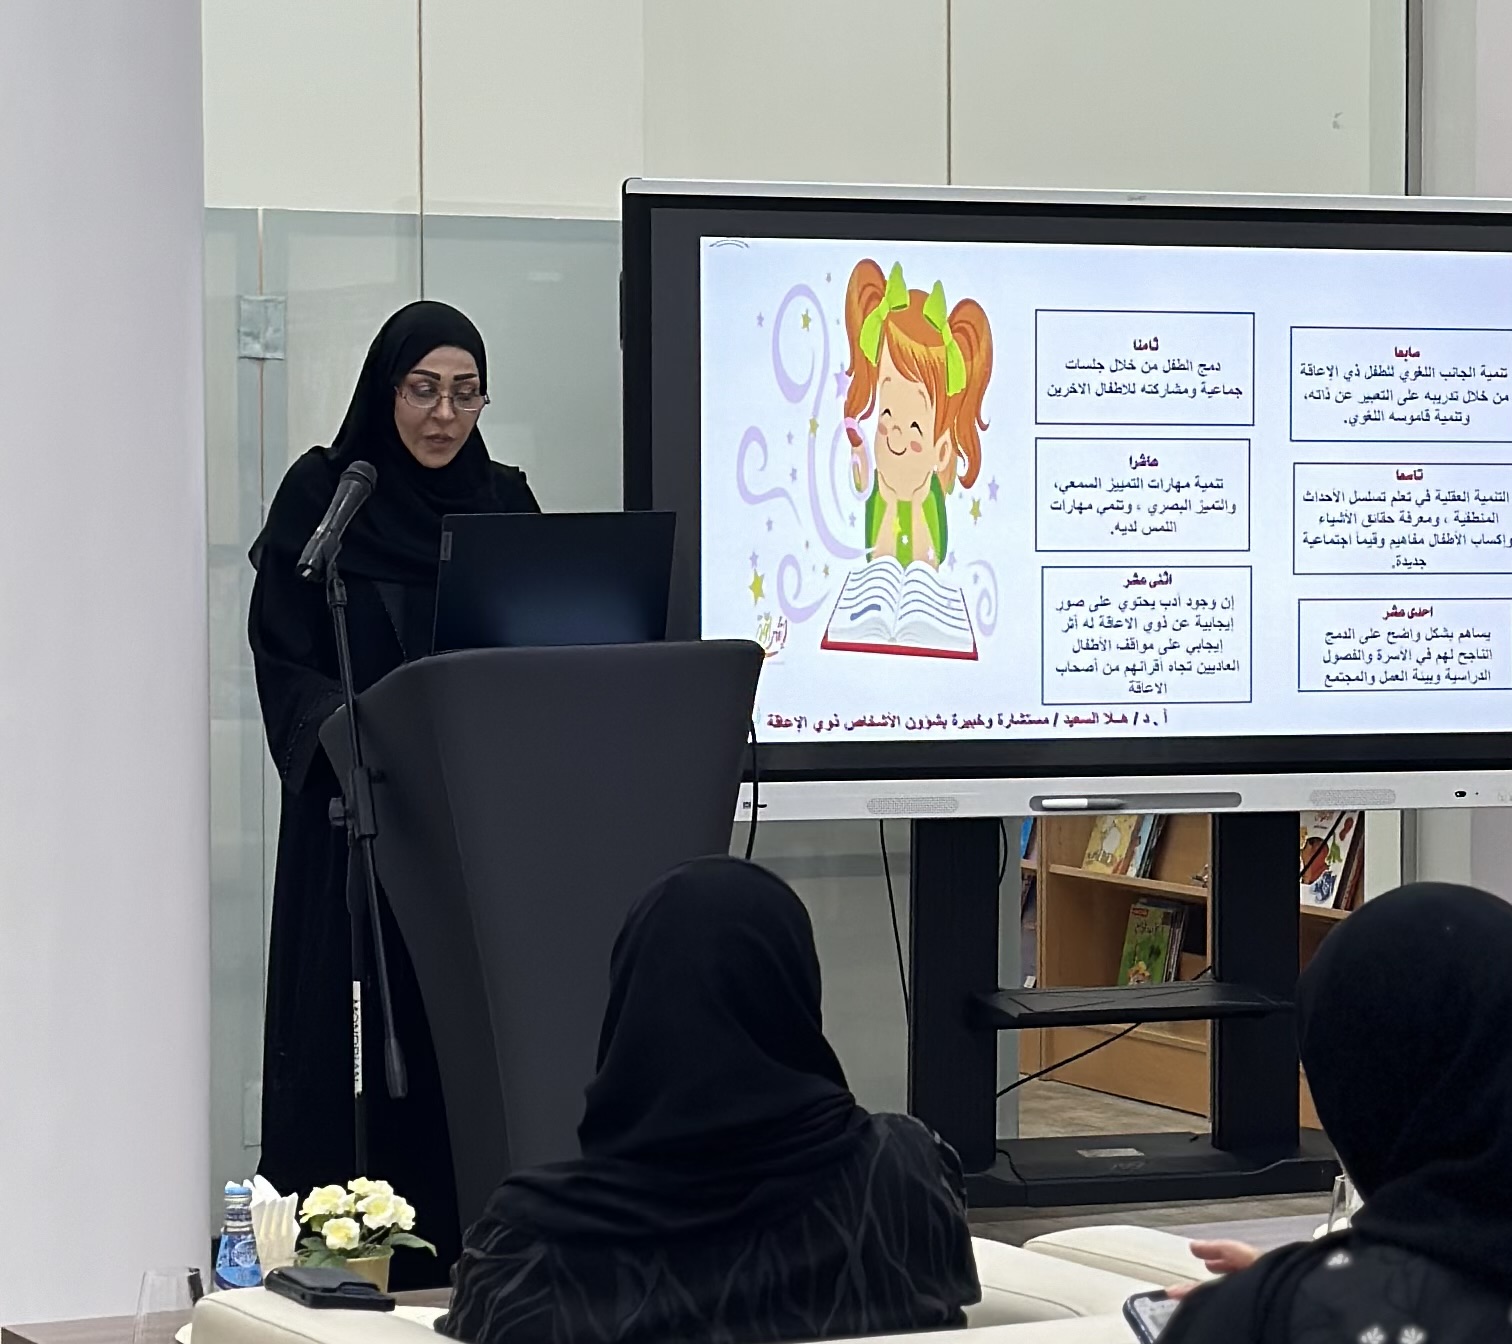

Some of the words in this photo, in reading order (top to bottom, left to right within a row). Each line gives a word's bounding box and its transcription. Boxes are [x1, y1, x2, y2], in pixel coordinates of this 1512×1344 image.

[1134, 337, 1158, 351] ثامنا
[1065, 359, 1104, 373] جلسات
[1110, 358, 1136, 373] خلال
[1141, 360, 1158, 373] من
[1163, 359, 1192, 372] الطفل
[1197, 358, 1221, 376] دمج
[1300, 363, 1338, 380] الإعاقة
[1343, 364, 1360, 381] ذي
[1364, 365, 1394, 379] للطفل
[1440, 366, 1475, 381] الجانب
[1481, 365, 1508, 381] تنمية
[1400, 367, 1435, 382] اللغوي
[1047, 382, 1090, 398] الاخرين
[1141, 384, 1196, 398] ومشاركته
[1200, 382, 1242, 398] جماعية
[1335, 389, 1352, 403] عن
[1358, 389, 1393, 404] التعبير
[1398, 389, 1418, 405] على
[1425, 389, 1458, 405] تدريبه
[1463, 390, 1488, 404] خلال
[1493, 391, 1509, 404] من
[1344, 410, 1384, 426] اللغوي.
[1389, 409, 1430, 425] قاموسه
[1434, 410, 1470, 425] وتنمية
[1107, 478, 1143, 492] التمييز
[1148, 477, 1190, 493] مهارات
[1194, 476, 1224, 490] تنمية
[1303, 488, 1344, 503] الأحداث
[1350, 490, 1386, 505] تسلسل
[1390, 490, 1411, 507] تعلم
[1415, 489, 1431, 506] في
[1435, 489, 1469, 505] العقلية
[1474, 490, 1509, 506] التنمية
[1050, 499, 1092, 514] مهارات
[1097, 500, 1132, 515] وتنمي
[1148, 499, 1191, 515] البصري
[1319, 509, 1356, 526] الأشياء
[1399, 510, 1439, 527] ومعرفة
[1111, 521, 1137, 535] لديه.
[1142, 521, 1176, 535] اللمس
[1303, 531, 1351, 549] اجتماعية
[1389, 534, 1424, 550] مفاهيم
[1429, 531, 1466, 548] الأطفال
[1056, 598, 1084, 611] صور
[1089, 594, 1111, 612] على
[1119, 595, 1155, 612] يحتوي
[1160, 593, 1181, 608] أدب
[1187, 596, 1216, 610] وجود
[1221, 594, 1234, 610] إن
[1062, 614, 1078, 633] أثر
[1083, 617, 1094, 629] له
[1099, 616, 1137, 630] الاعاقة
[1172, 618, 1189, 630] عن
[1195, 616, 1233, 631] إيجابية
[1325, 628, 1354, 644] الدمج
[1359, 628, 1380, 644] على
[1387, 627, 1420, 644] واضح
[1425, 626, 1453, 641] بشكل
[1458, 627, 1490, 641] يساهم
[1073, 637, 1111, 654] الأطفال
[1117, 639, 1154, 654] مواقف
[1158, 639, 1180, 655] على
[1186, 639, 1223, 655] إيجابي
[1323, 649, 1373, 664] والفصول
[1377, 648, 1411, 663] الأسرة
[1415, 647, 1431, 664] في
[1435, 648, 1453, 664] لهم
[1457, 648, 1492, 664] الناجح
[1056, 658, 1098, 676] أصحاب
[1103, 661, 1119, 675] من
[1124, 658, 1163, 676] أقرانهم
[1168, 661, 1192, 675] تجاه
[1197, 660, 1239, 675] العاديين
[1325, 671, 1375, 687] والمجتمع
[1379, 670, 1407, 685] العمل
[1412, 669, 1440, 685] وبيئة
[1445, 668, 1490, 685] الدراسية
[767, 714, 807, 732] الإعاقة
[813, 714, 839, 732] ذوي
[844, 712, 900, 731] الأشخاص
[952, 712, 993, 730] وخبيرة
[997, 713, 1049, 729] مستشارة
[1064, 712, 1099, 727] السعيد
